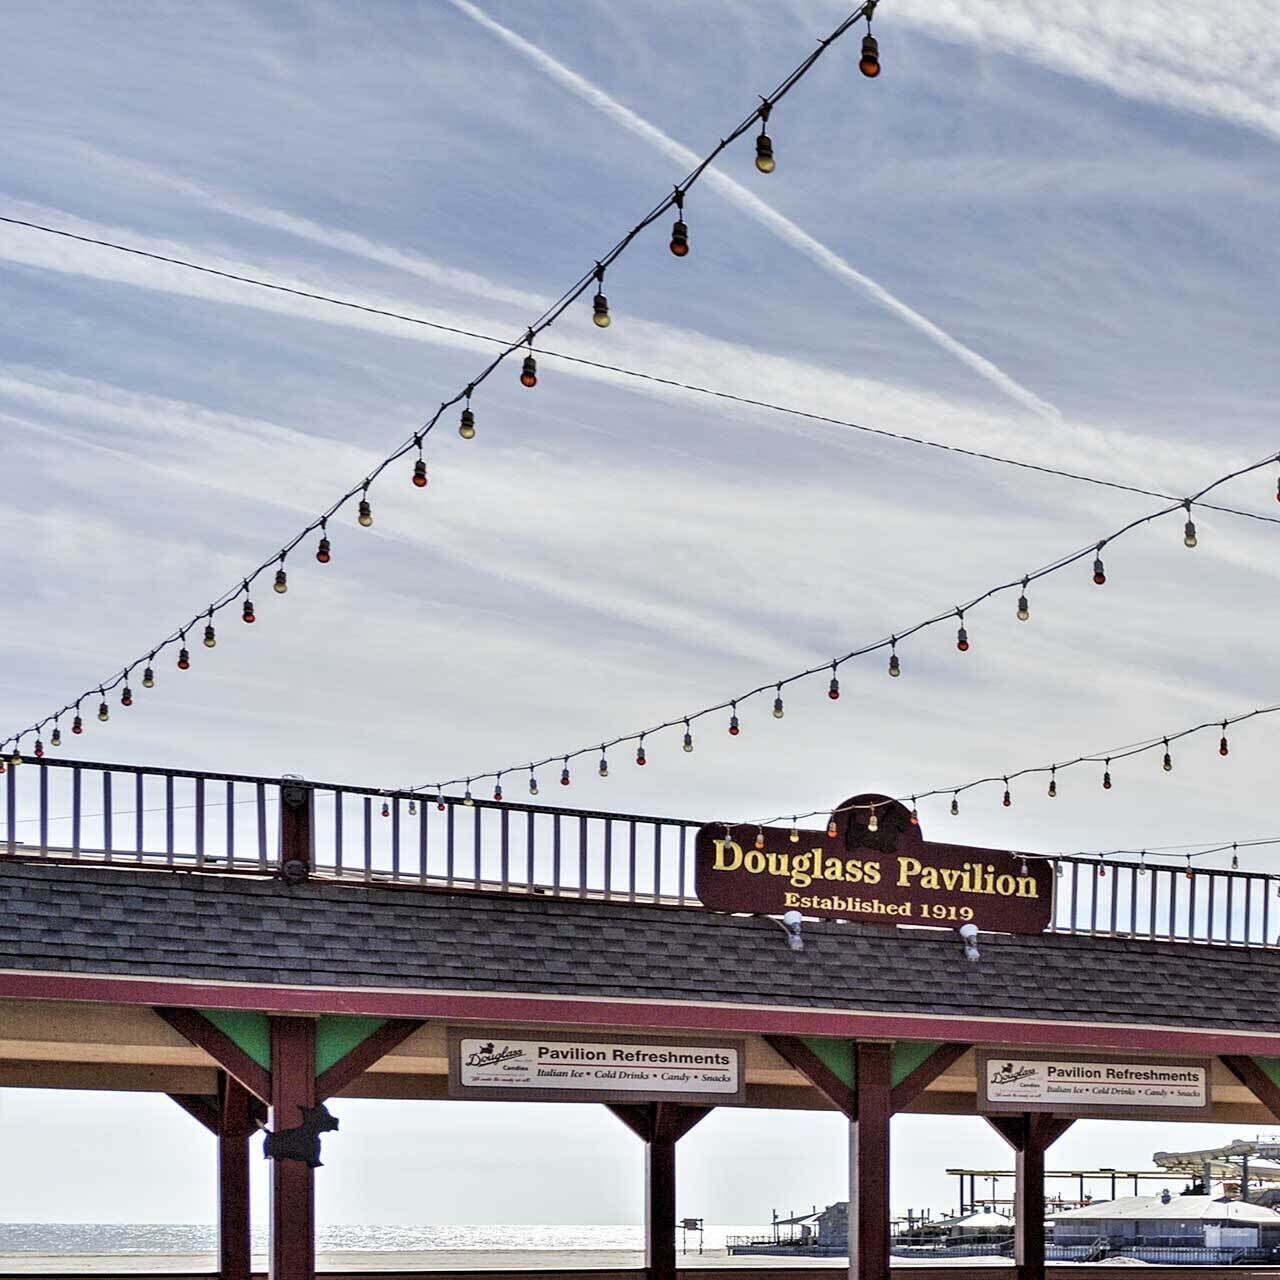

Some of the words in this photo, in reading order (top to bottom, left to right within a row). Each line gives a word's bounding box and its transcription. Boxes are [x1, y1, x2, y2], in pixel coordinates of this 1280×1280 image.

[712, 839, 881, 888] Douglass
[896, 856, 1039, 898] Pavilion
[784, 892, 912, 917] Established
[920, 903, 975, 921] 1919
[465, 1046, 527, 1068] Douglass
[537, 1046, 606, 1061] Pavilion
[612, 1049, 730, 1065] Refreshments
[537, 1069, 568, 1078] Italian
[570, 1070, 584, 1078] Ice
[594, 1070, 616, 1079] Cold
[619, 1071, 649, 1080] Drinks
[661, 1073, 690, 1083] Candy
[701, 1074, 731, 1082] Snacks
[1047, 1066, 1101, 1079] Pavilion
[1106, 1068, 1199, 1082] Refreshments
[1073, 1086, 1084, 1094] Ice
[1092, 1087, 1110, 1095] Cold
[1111, 1088, 1136, 1096] Drinks
[1145, 1089, 1167, 1098] Candy
